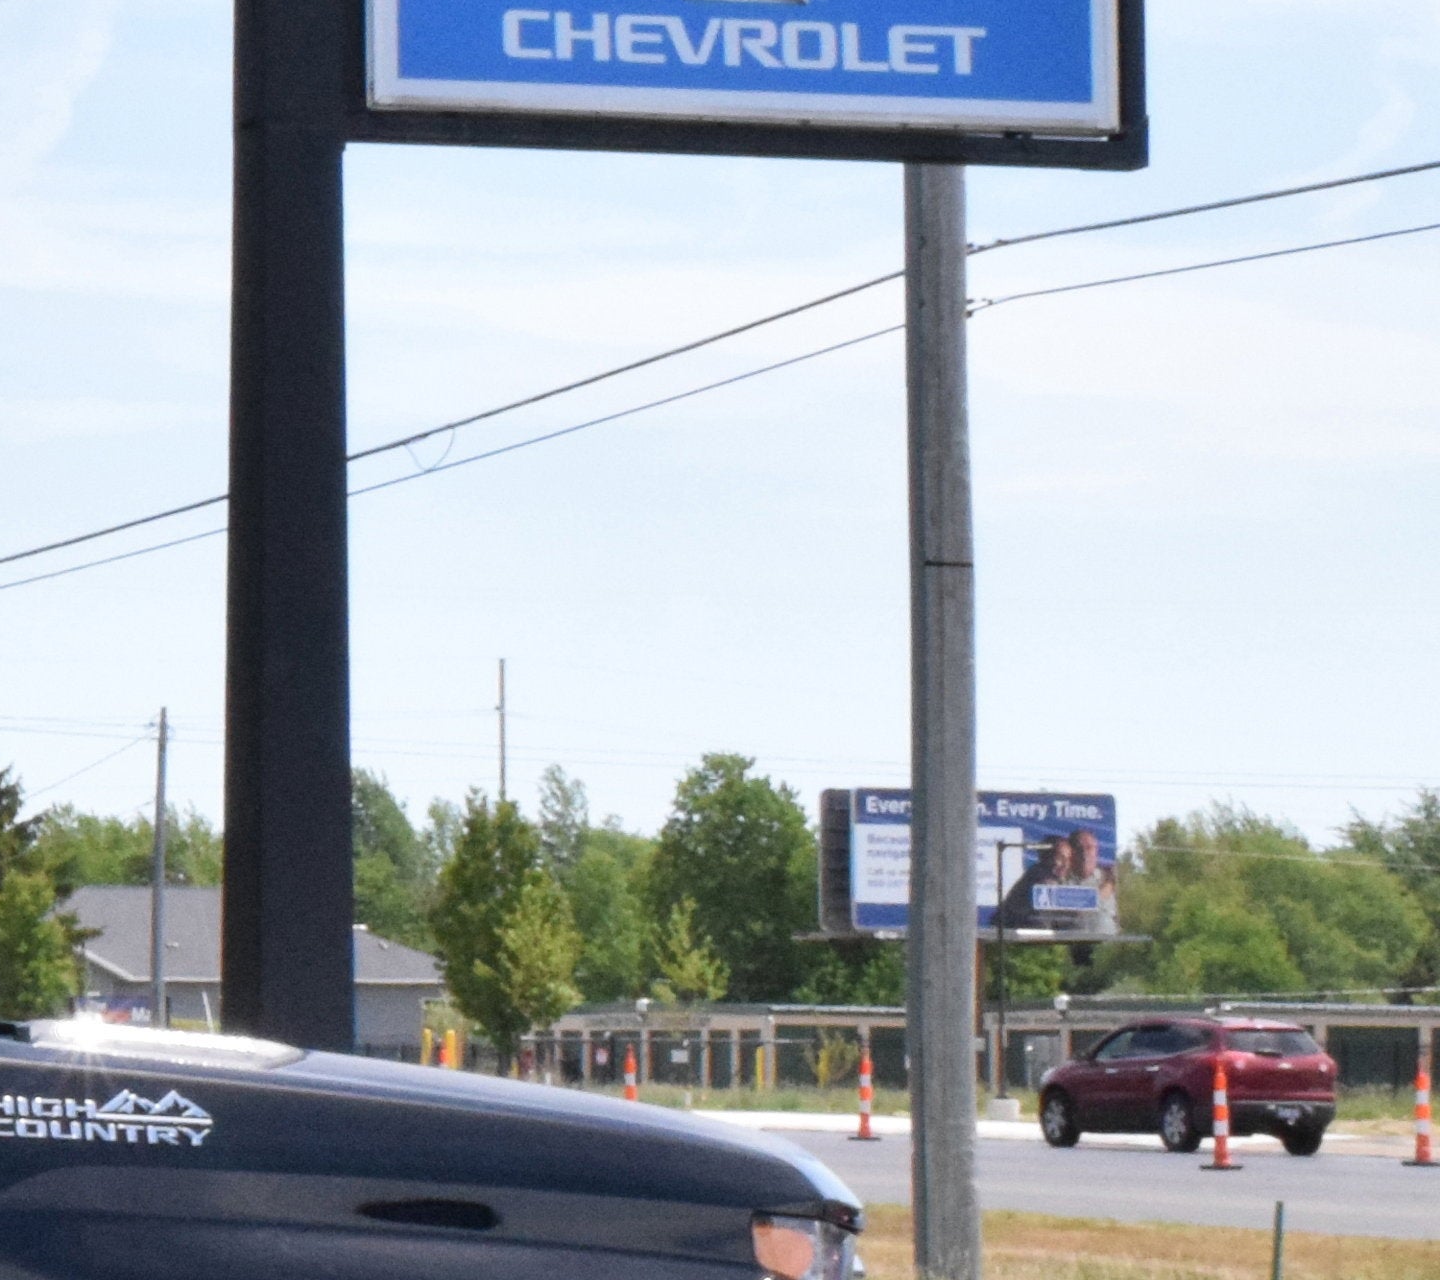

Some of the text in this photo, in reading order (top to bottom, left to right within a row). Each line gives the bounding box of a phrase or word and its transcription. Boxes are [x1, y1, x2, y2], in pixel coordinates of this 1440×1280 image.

[502, 9, 986, 75] CHEVROLET
[996, 799, 1048, 820] Every
[1053, 800, 1103, 819] Time.
